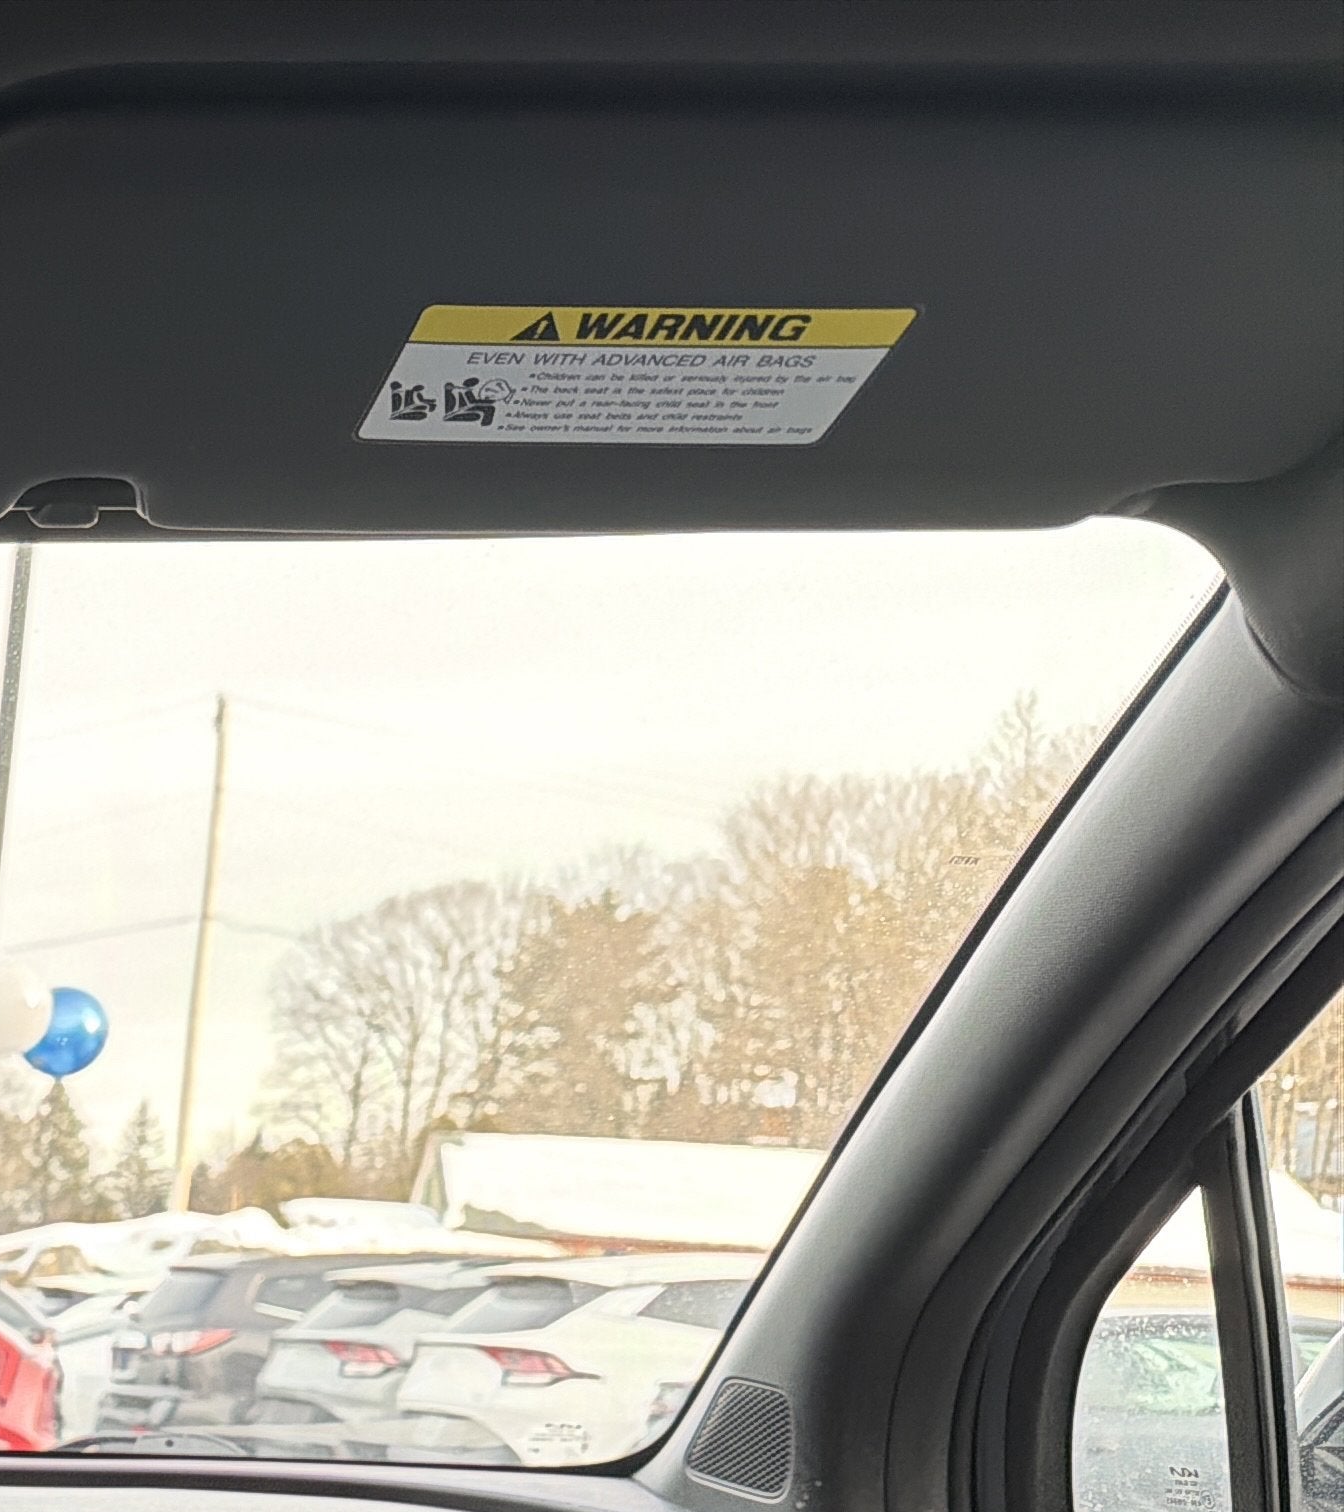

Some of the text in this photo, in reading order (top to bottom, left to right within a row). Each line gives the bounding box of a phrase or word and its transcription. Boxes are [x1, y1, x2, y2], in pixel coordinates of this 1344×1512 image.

[574, 313, 812, 342] WARNING
[466, 351, 817, 368] EVEN WITH ADVANCED AIR BAGS
